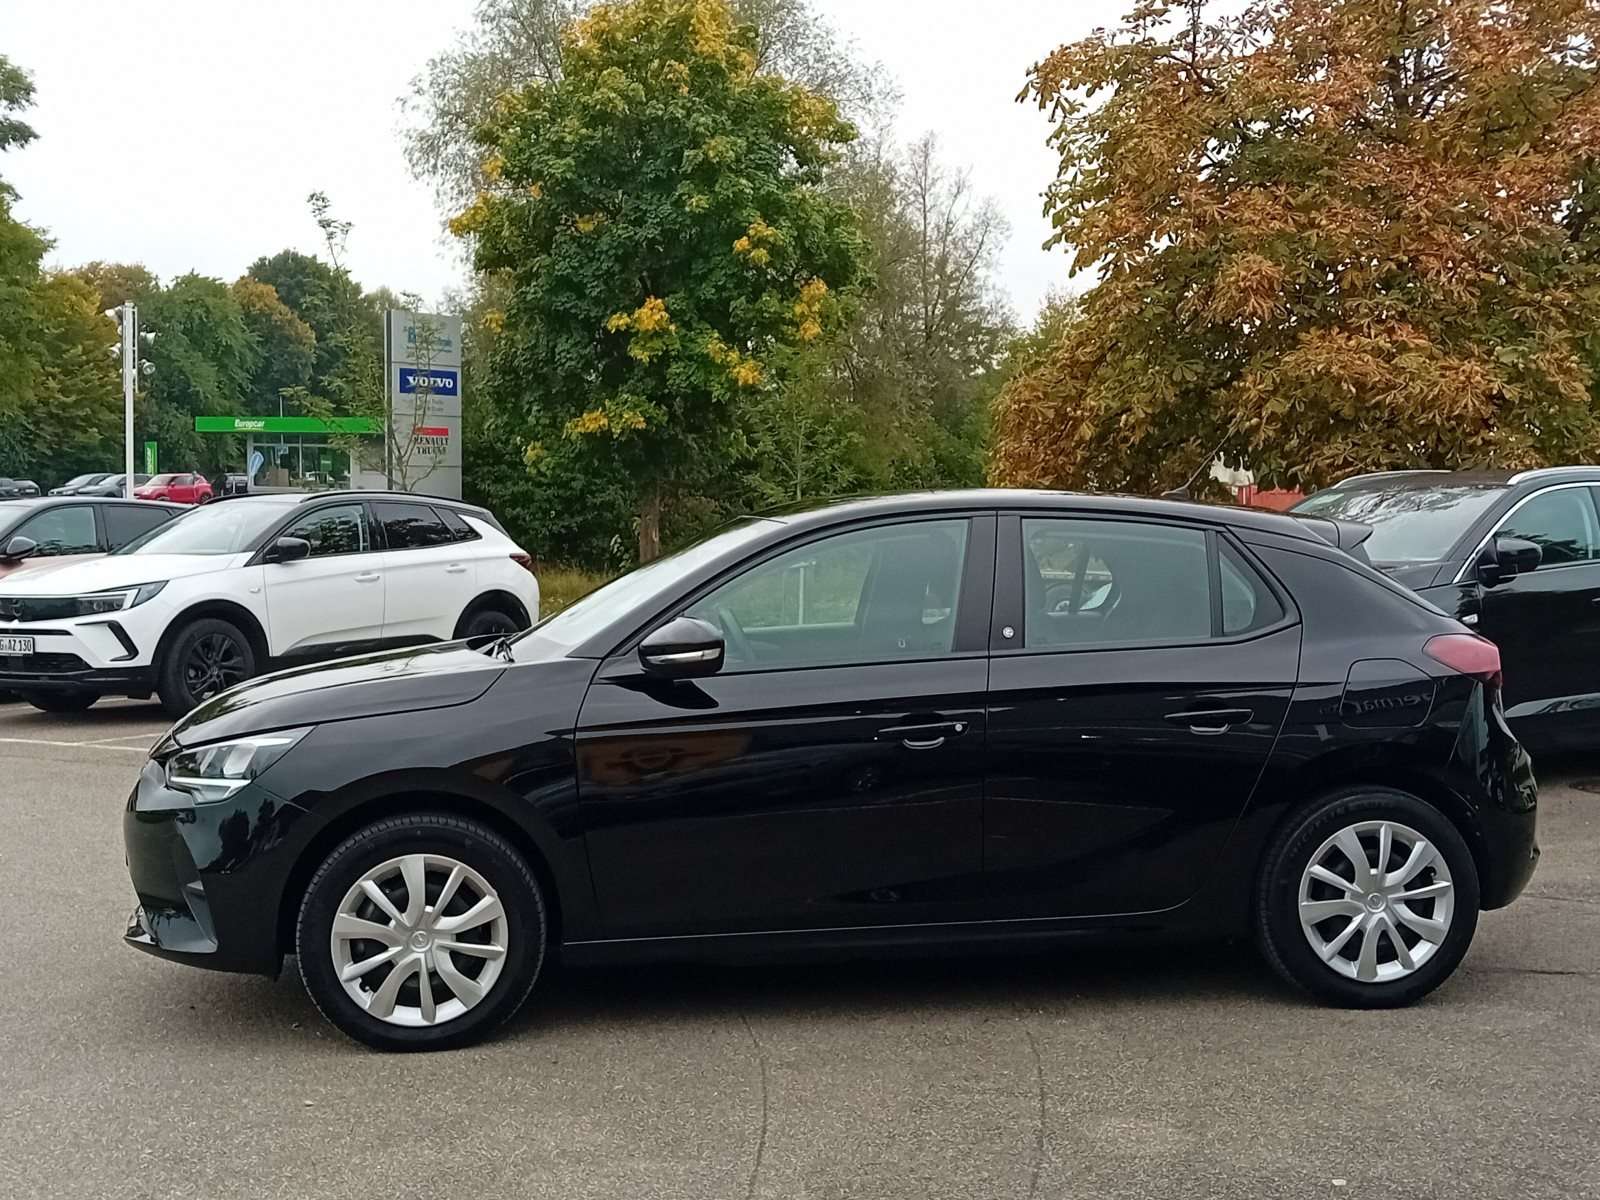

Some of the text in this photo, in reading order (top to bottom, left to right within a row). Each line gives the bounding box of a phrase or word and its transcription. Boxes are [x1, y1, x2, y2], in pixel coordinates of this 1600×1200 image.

[406, 375, 454, 389] VOLVO
[234, 418, 265, 429] Europcar
[18, 639, 32, 651] 130
